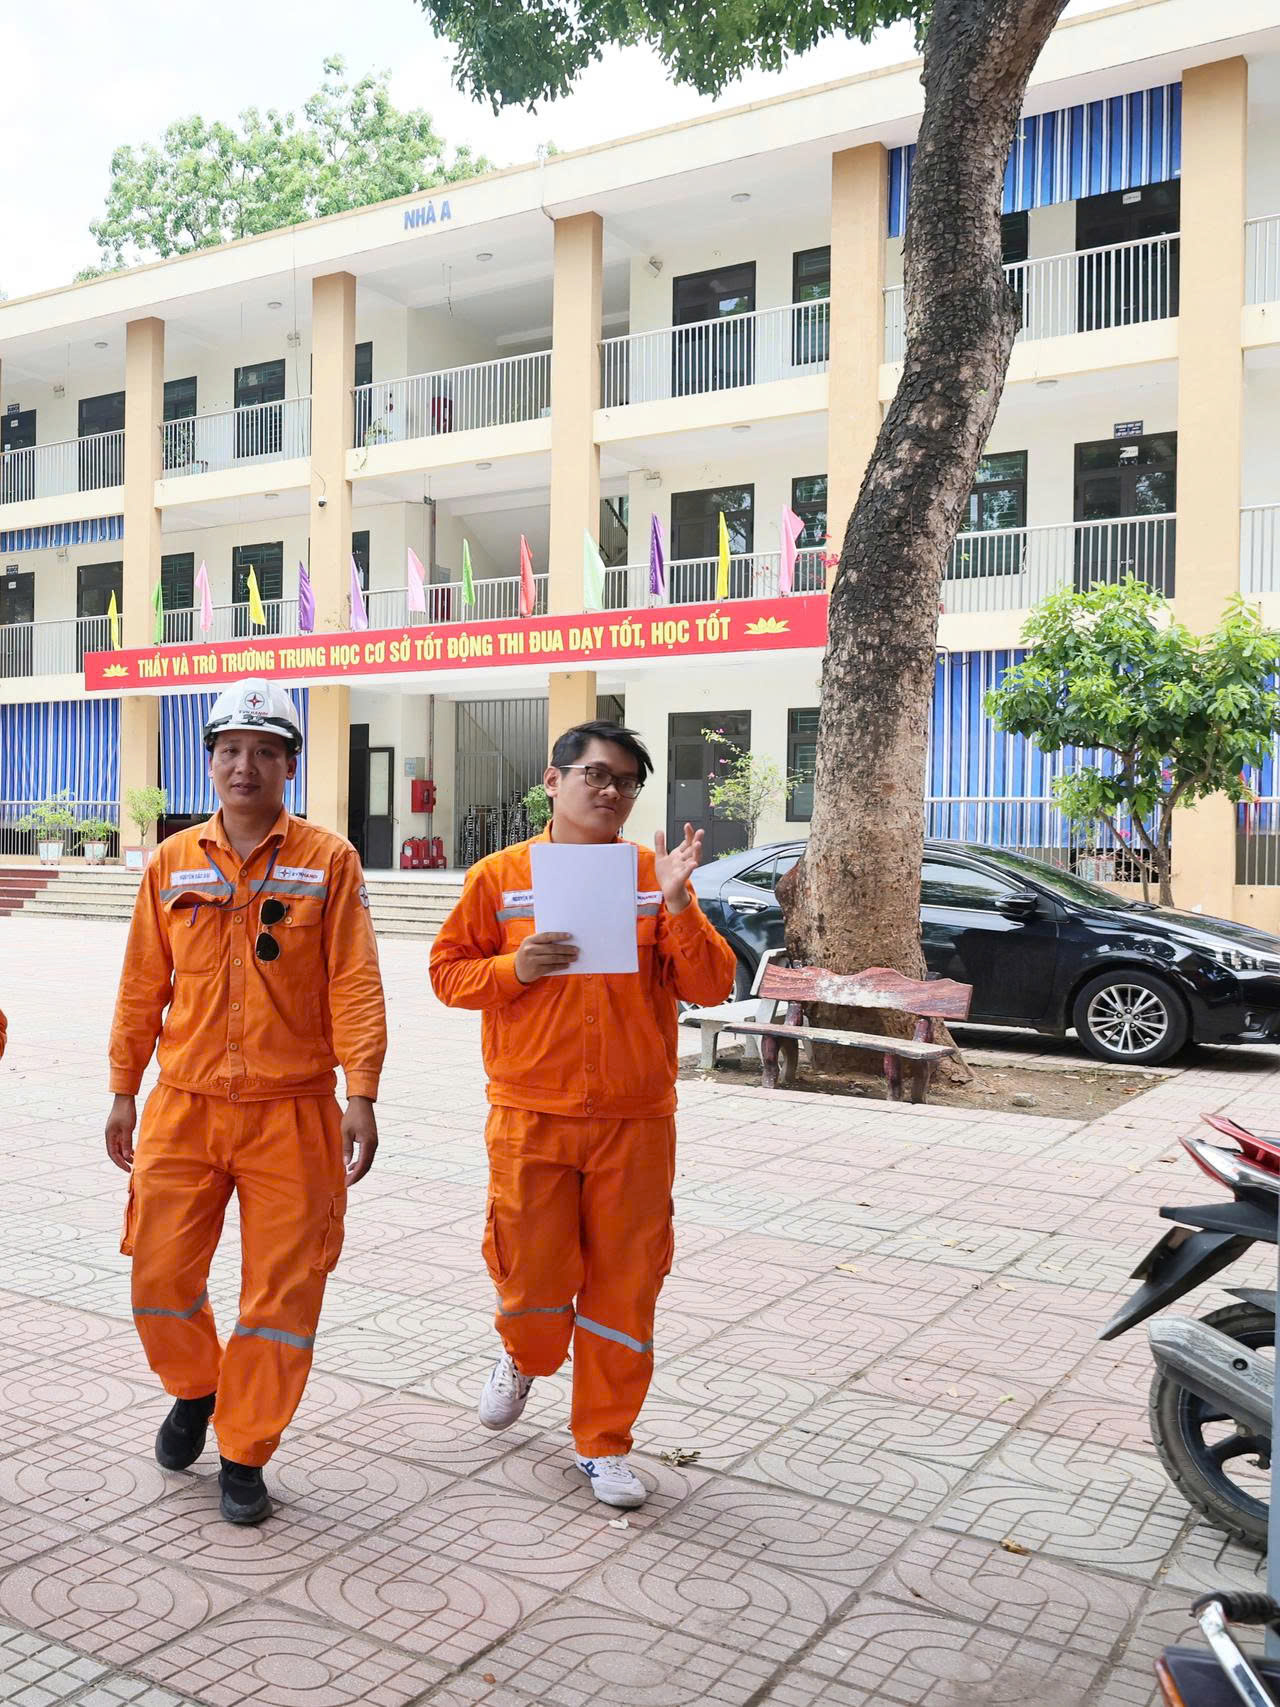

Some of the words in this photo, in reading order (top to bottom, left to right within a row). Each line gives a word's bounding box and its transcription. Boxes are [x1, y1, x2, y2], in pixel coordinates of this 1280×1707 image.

[404, 200, 436, 230] NHÀ
[440, 200, 451, 221] A
[138, 652, 169, 678] THẦY
[172, 652, 189, 676] VÀ
[192, 650, 217, 674] TRÒ
[221, 647, 275, 673] TRƯỜNG
[279, 646, 326, 669] TRUNG
[330, 644, 360, 670] HỌC
[365, 640, 386, 664] CƠ
[389, 634, 411, 662] SỞ
[415, 631, 443, 661] TỐT
[447, 632, 493, 662] ĐỘNG
[498, 632, 524, 655] THI
[529, 629, 564, 653] ĐUA
[569, 626, 604, 654] DẠY
[609, 616, 645, 648] TỐT,
[651, 620, 690, 649] HỌC
[696, 609, 731, 642] TỐT
